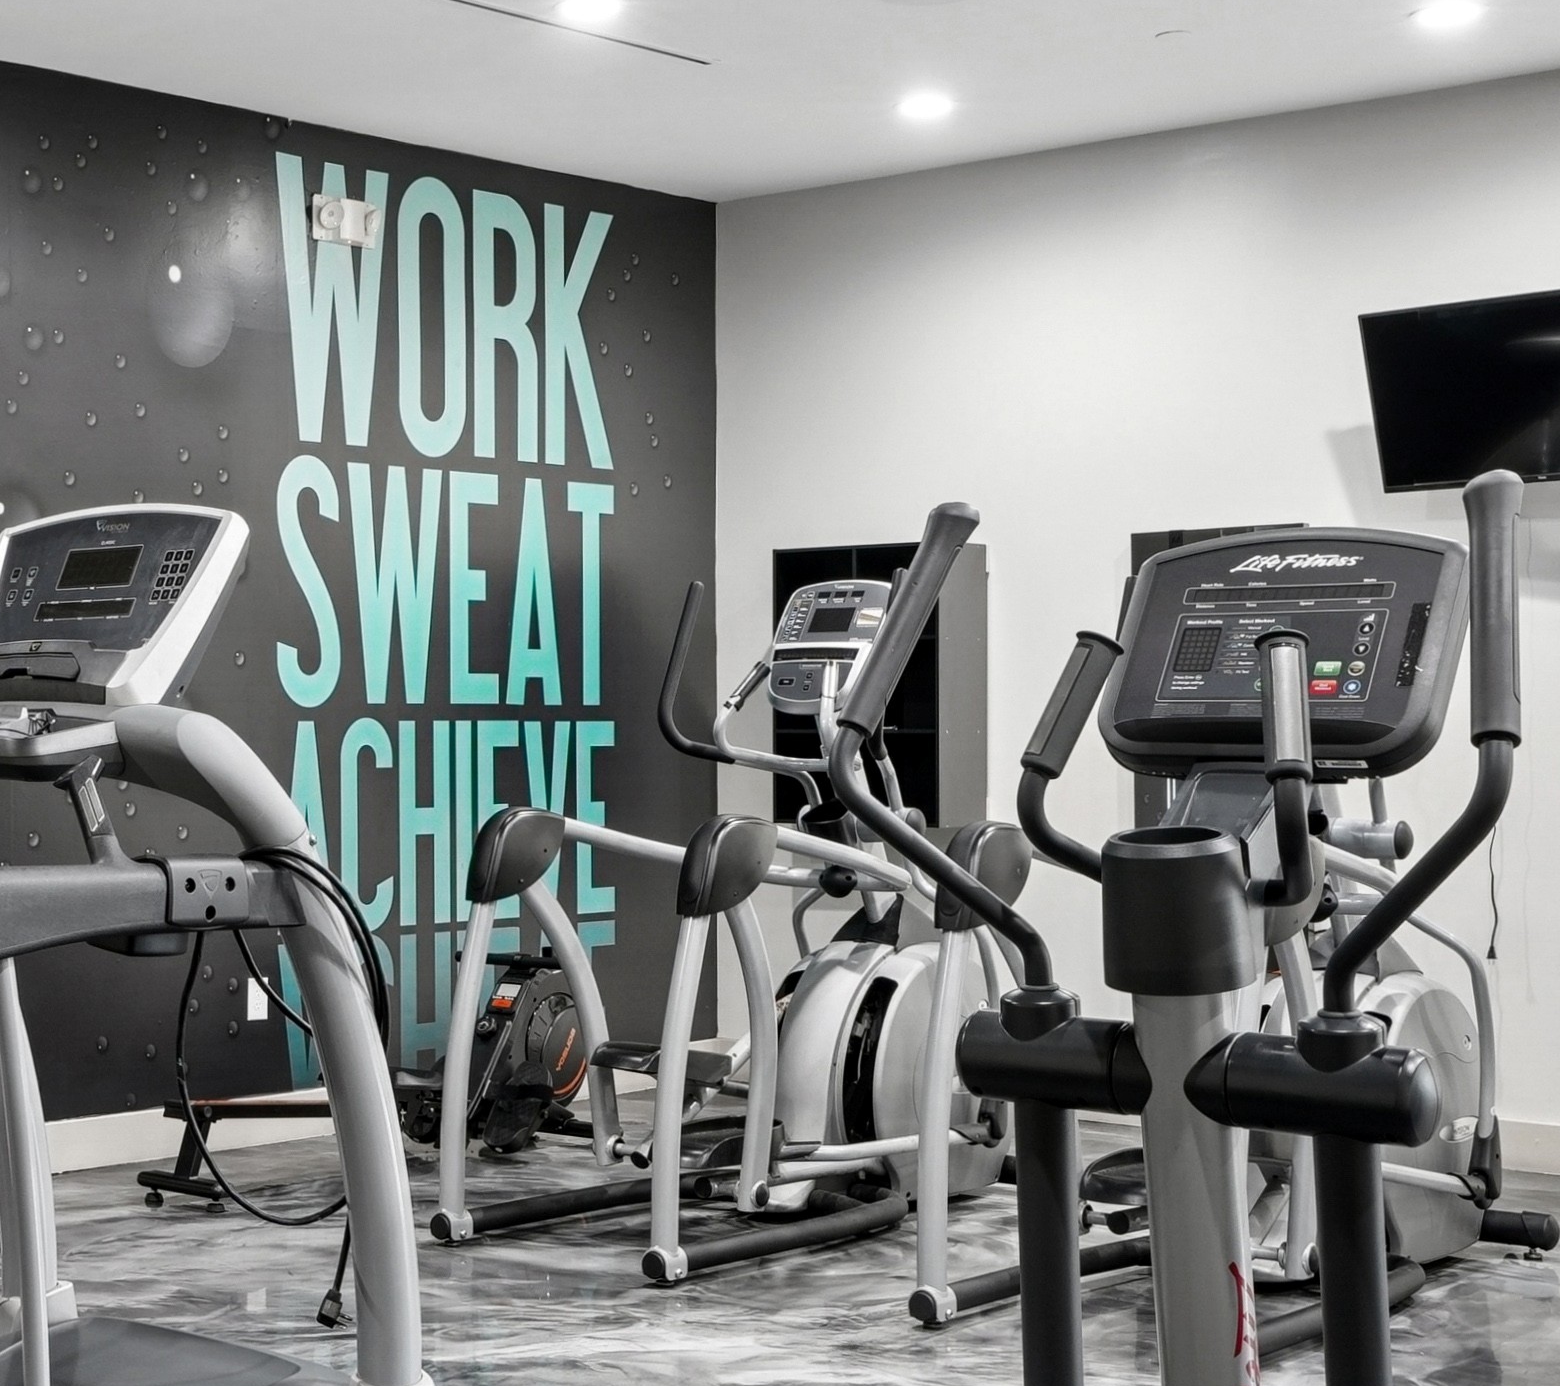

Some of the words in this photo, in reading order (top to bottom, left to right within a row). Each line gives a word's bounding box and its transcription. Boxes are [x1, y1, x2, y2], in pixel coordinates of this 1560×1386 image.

[275, 150, 614, 471] WORK
[276, 454, 614, 708] SWEAT
[1230, 554, 1280, 573] Life
[1275, 553, 1362, 572] Fitness
